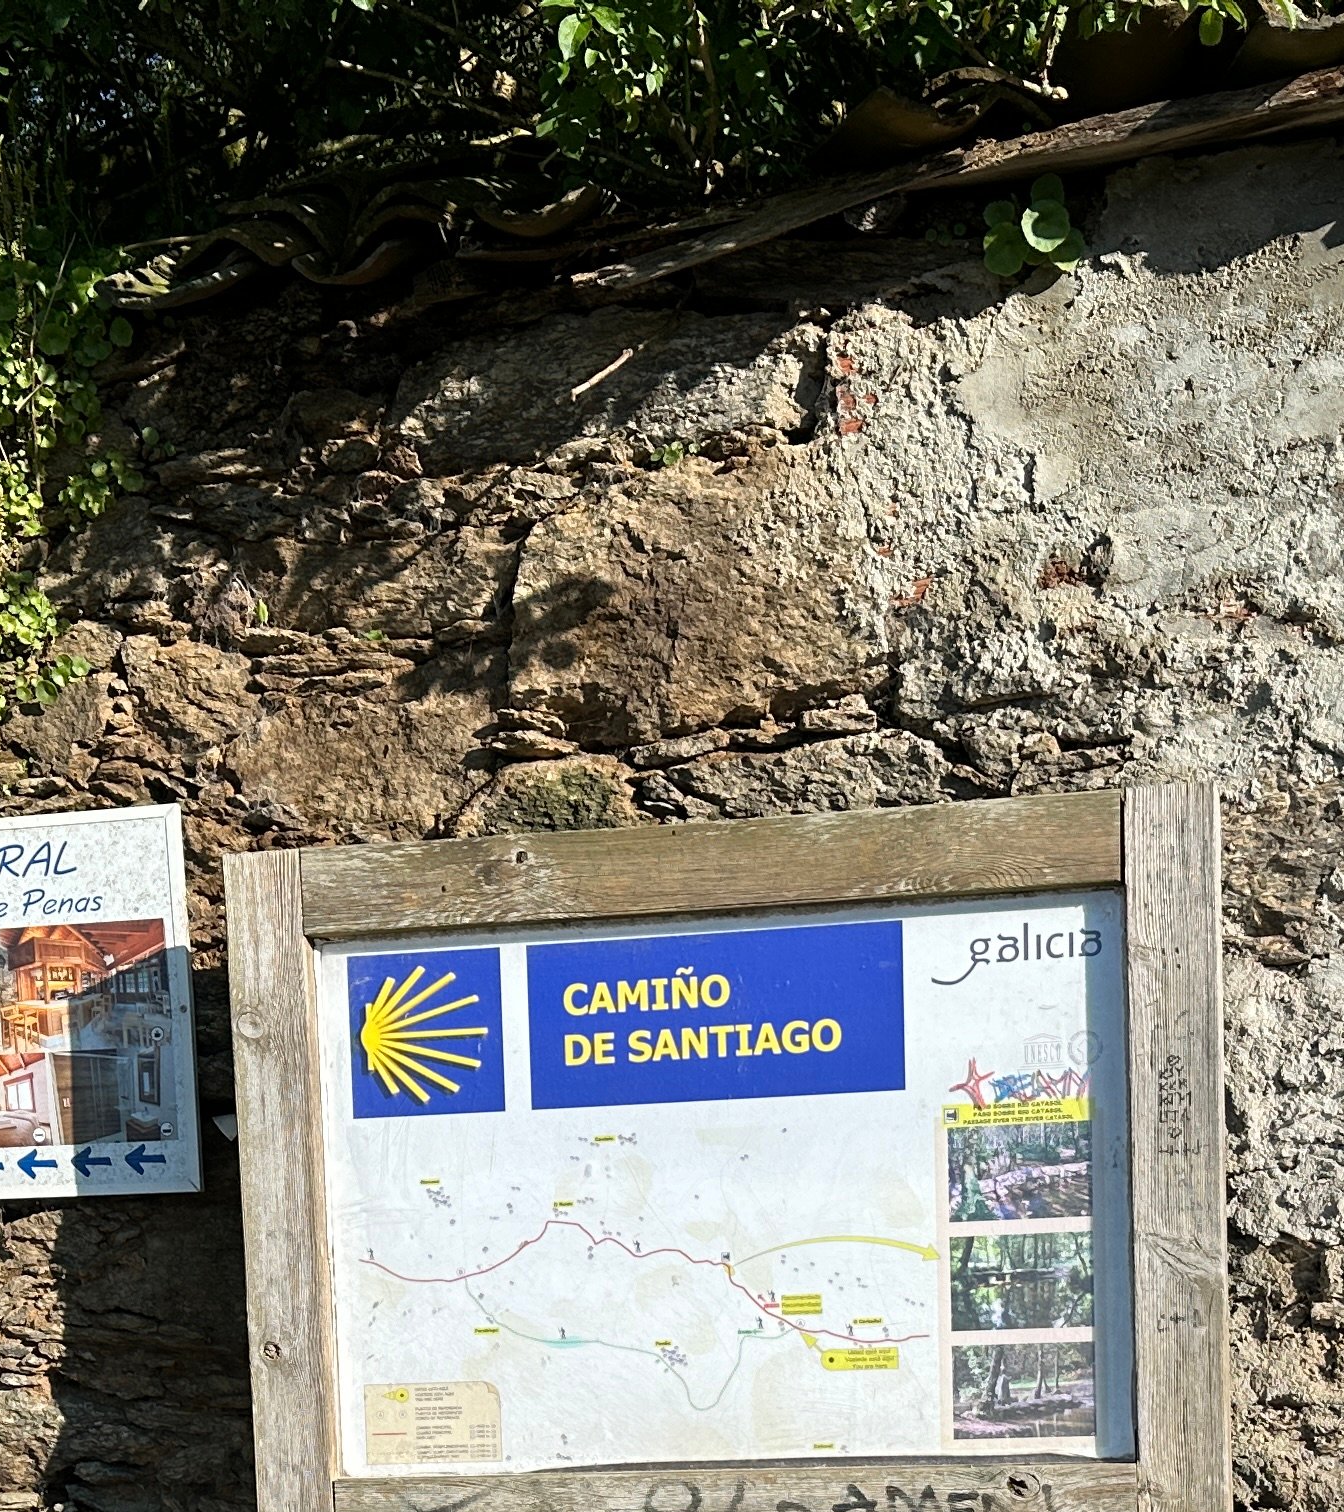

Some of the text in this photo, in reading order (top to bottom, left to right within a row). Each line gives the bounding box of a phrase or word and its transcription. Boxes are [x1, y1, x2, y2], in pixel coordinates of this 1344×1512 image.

[22, 888, 104, 916] Penas
[931, 922, 1103, 986] galicia
[562, 965, 731, 1016] CAMIÑO
[564, 1018, 843, 1067] DE SANTIAGO
[1023, 1042, 1063, 1064] UNESCO
